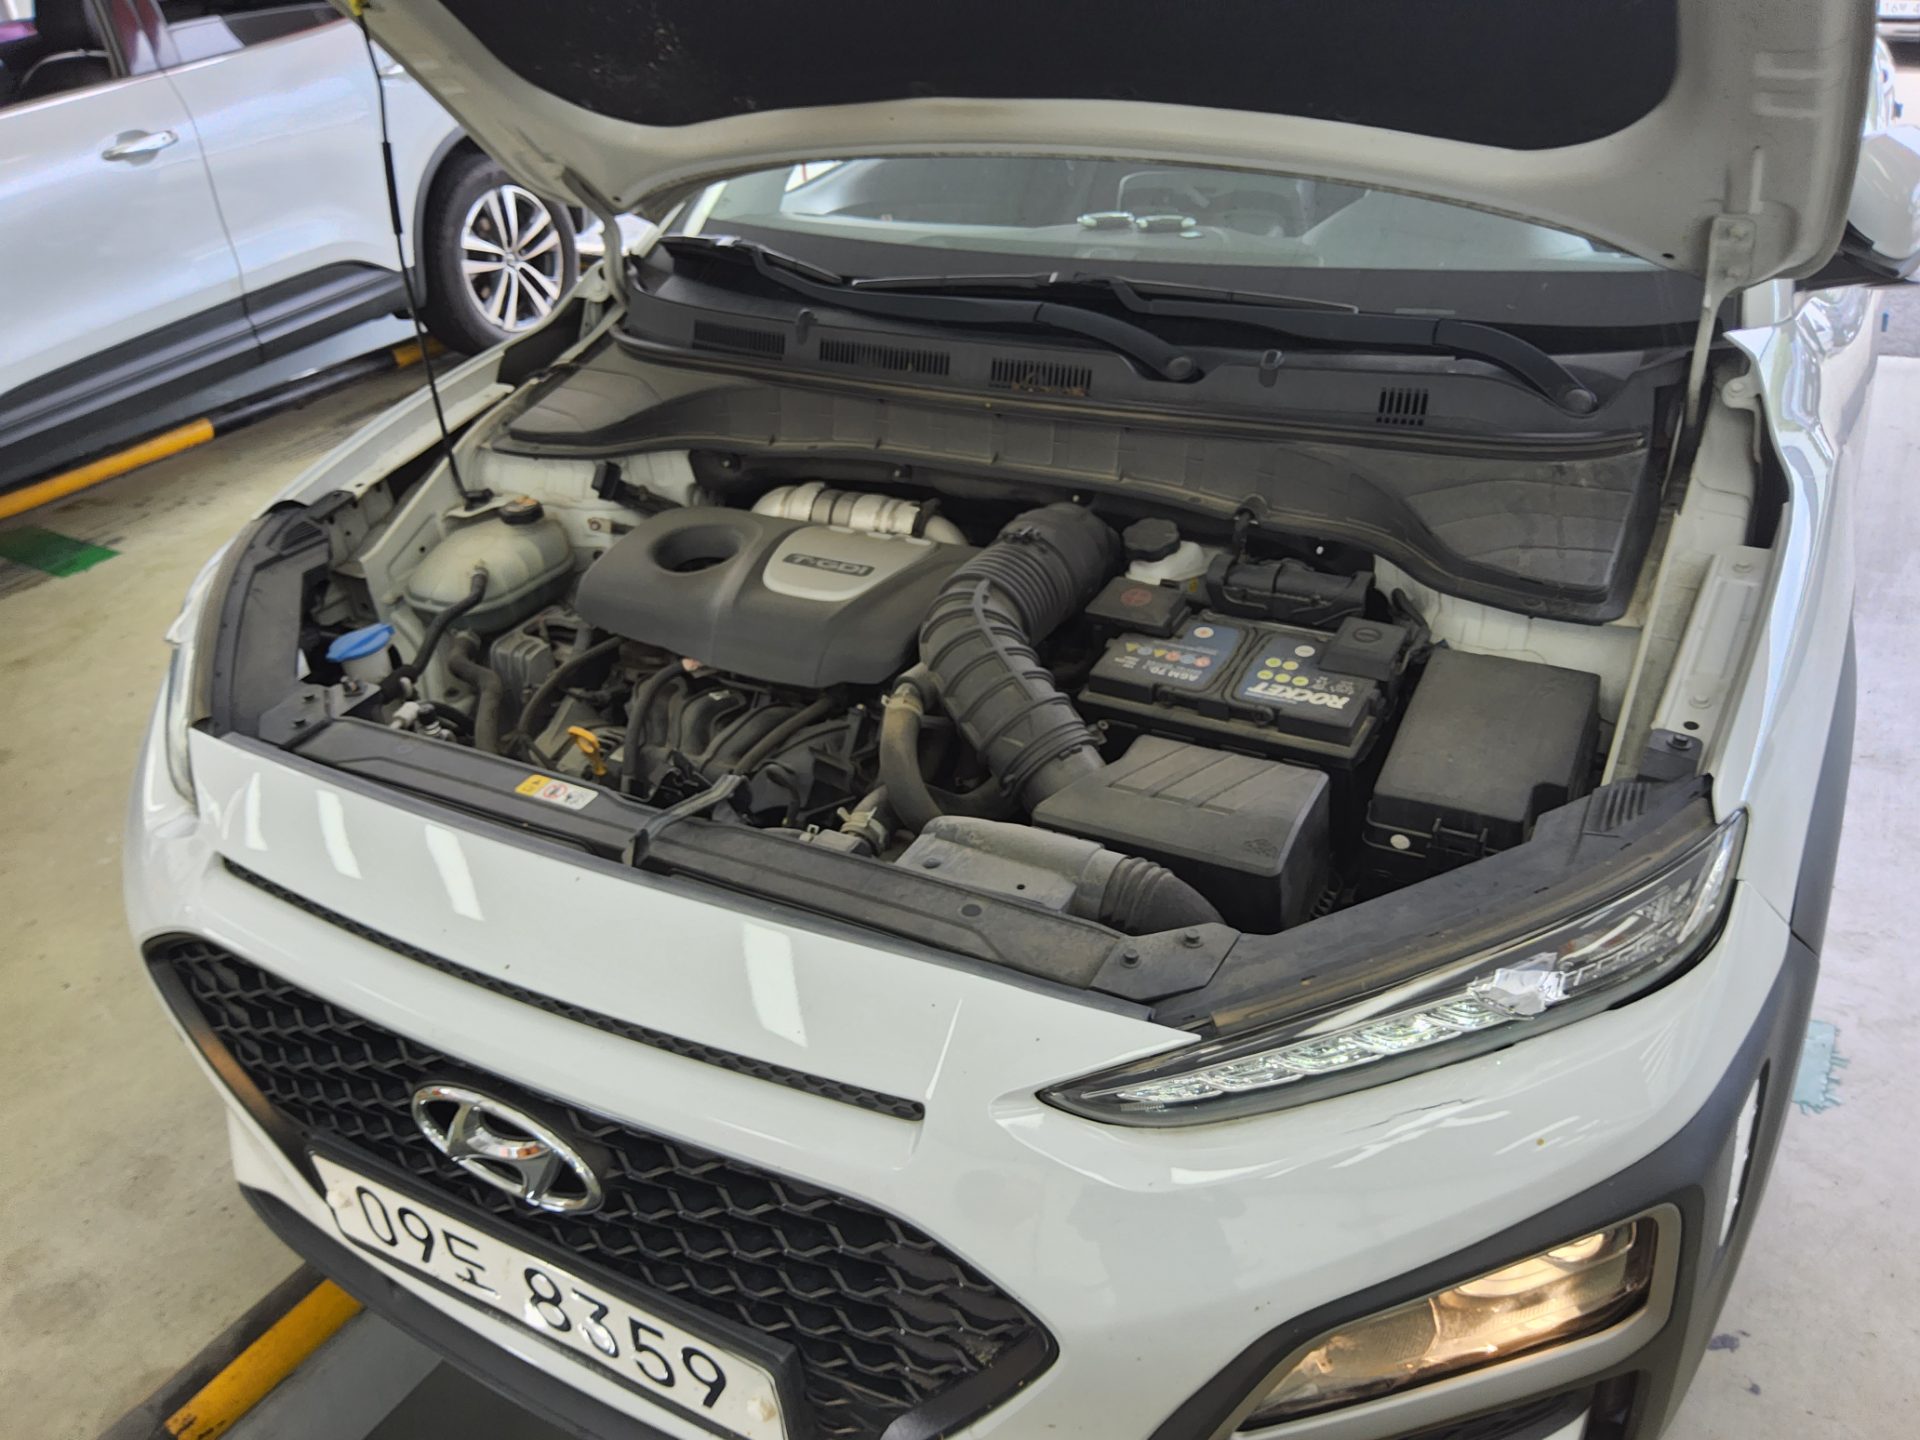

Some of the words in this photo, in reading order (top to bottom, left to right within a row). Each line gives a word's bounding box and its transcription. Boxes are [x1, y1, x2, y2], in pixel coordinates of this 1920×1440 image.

[1247, 682, 1350, 709] ROCKET
[356, 1185, 501, 1300] 09도
[523, 1267, 727, 1409] 8359
